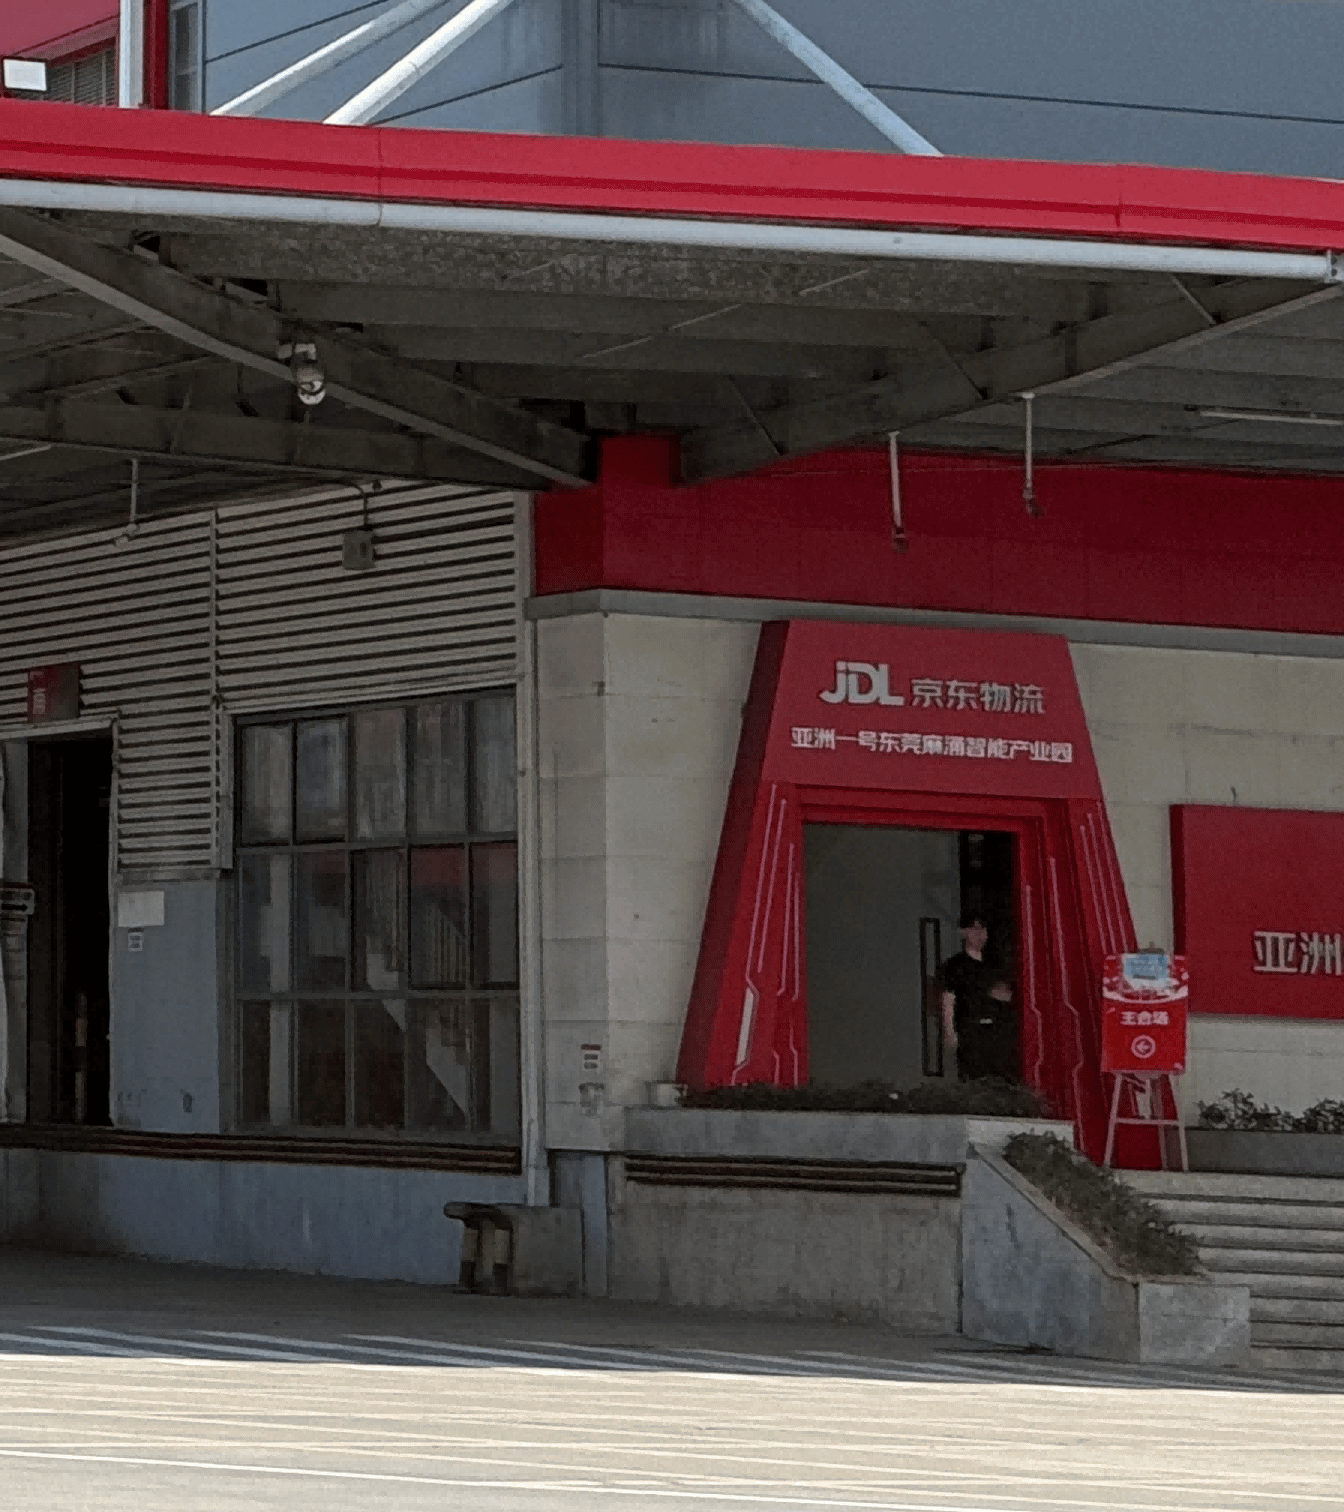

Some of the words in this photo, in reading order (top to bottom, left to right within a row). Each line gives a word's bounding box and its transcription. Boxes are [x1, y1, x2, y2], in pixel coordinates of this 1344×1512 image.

[820, 661, 904, 705] JDL
[911, 678, 1046, 714] 京东物流
[791, 727, 1073, 763] 亚洲一号东莞麻涌智能产业园
[1253, 931, 1343, 976] 亚洲
